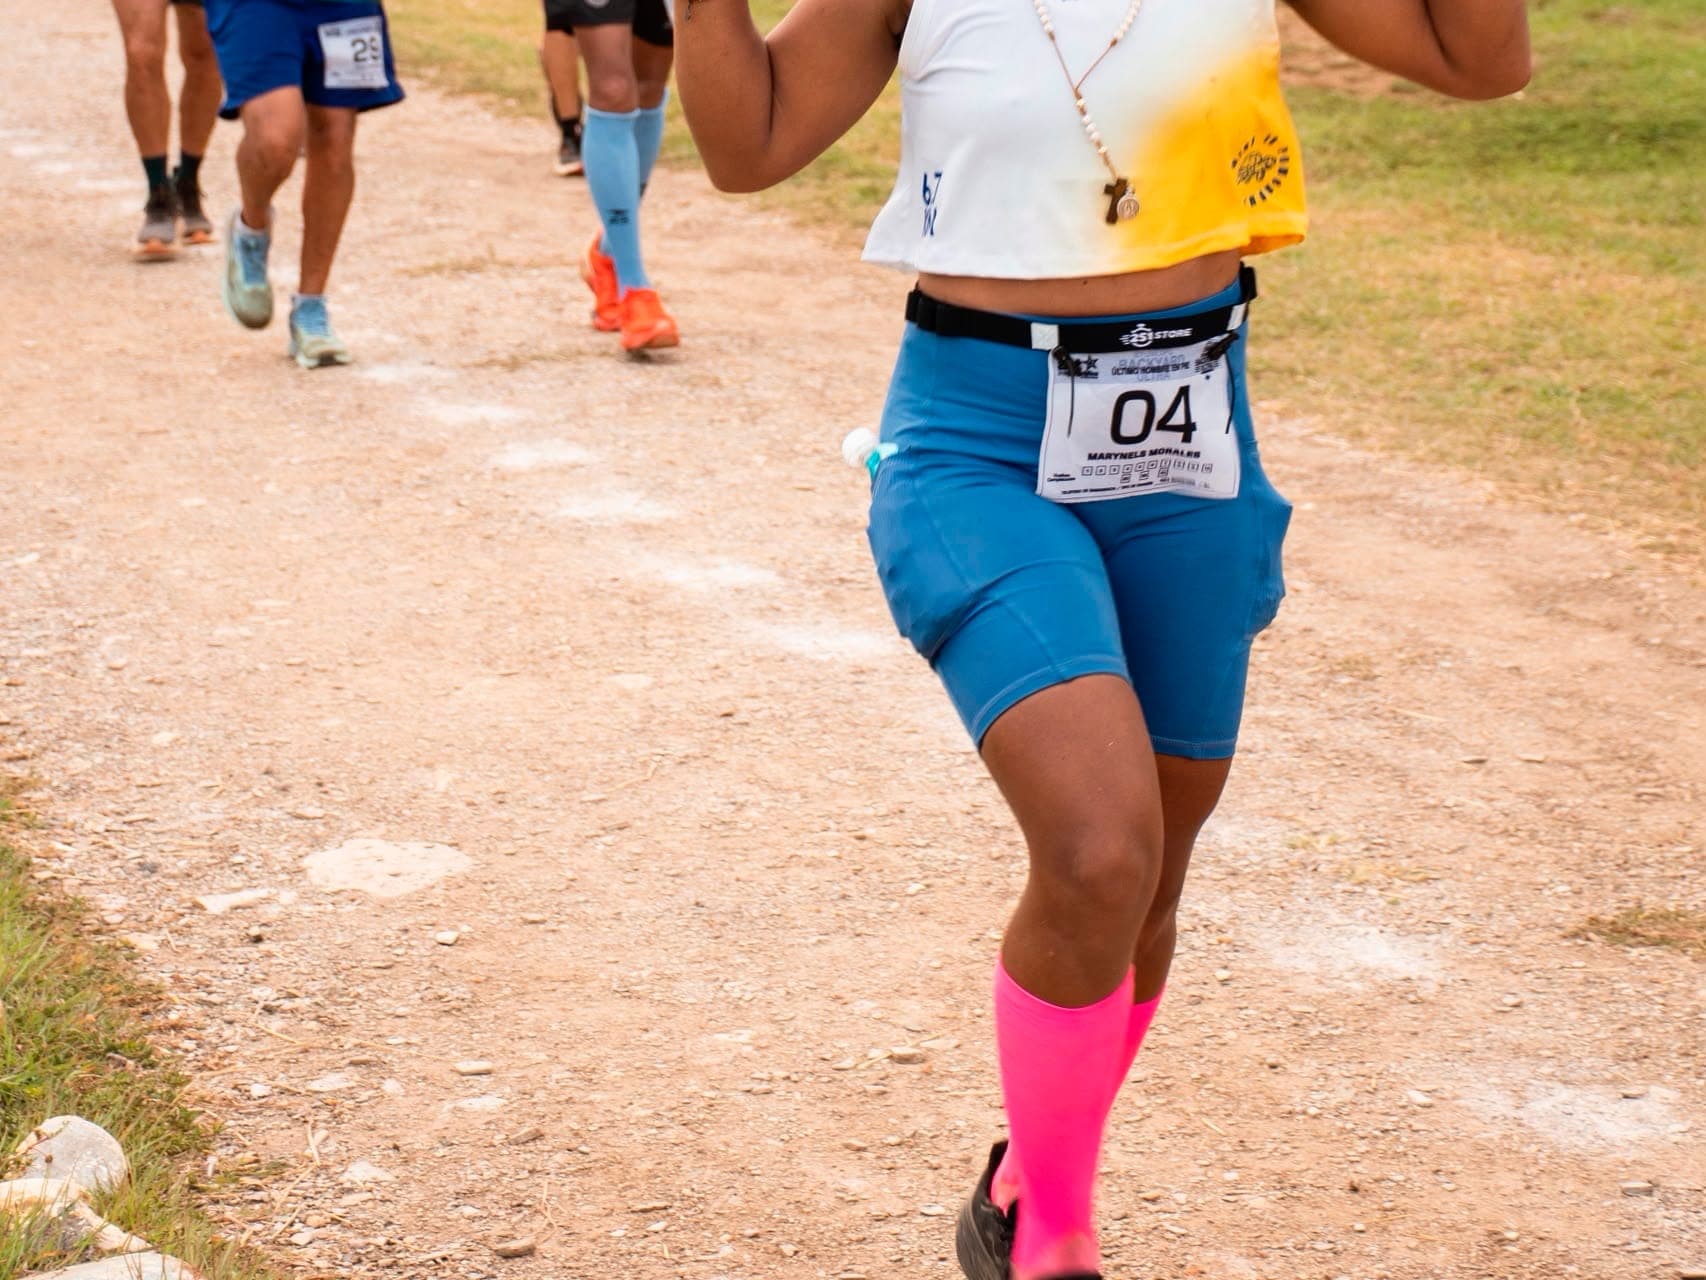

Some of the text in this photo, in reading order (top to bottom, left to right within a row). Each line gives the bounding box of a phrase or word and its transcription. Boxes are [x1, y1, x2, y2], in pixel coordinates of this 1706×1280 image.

[1154, 328, 1194, 339] STORE
[1110, 384, 1198, 445] 04
[1087, 447, 1201, 461] MARYNELS MORALES
